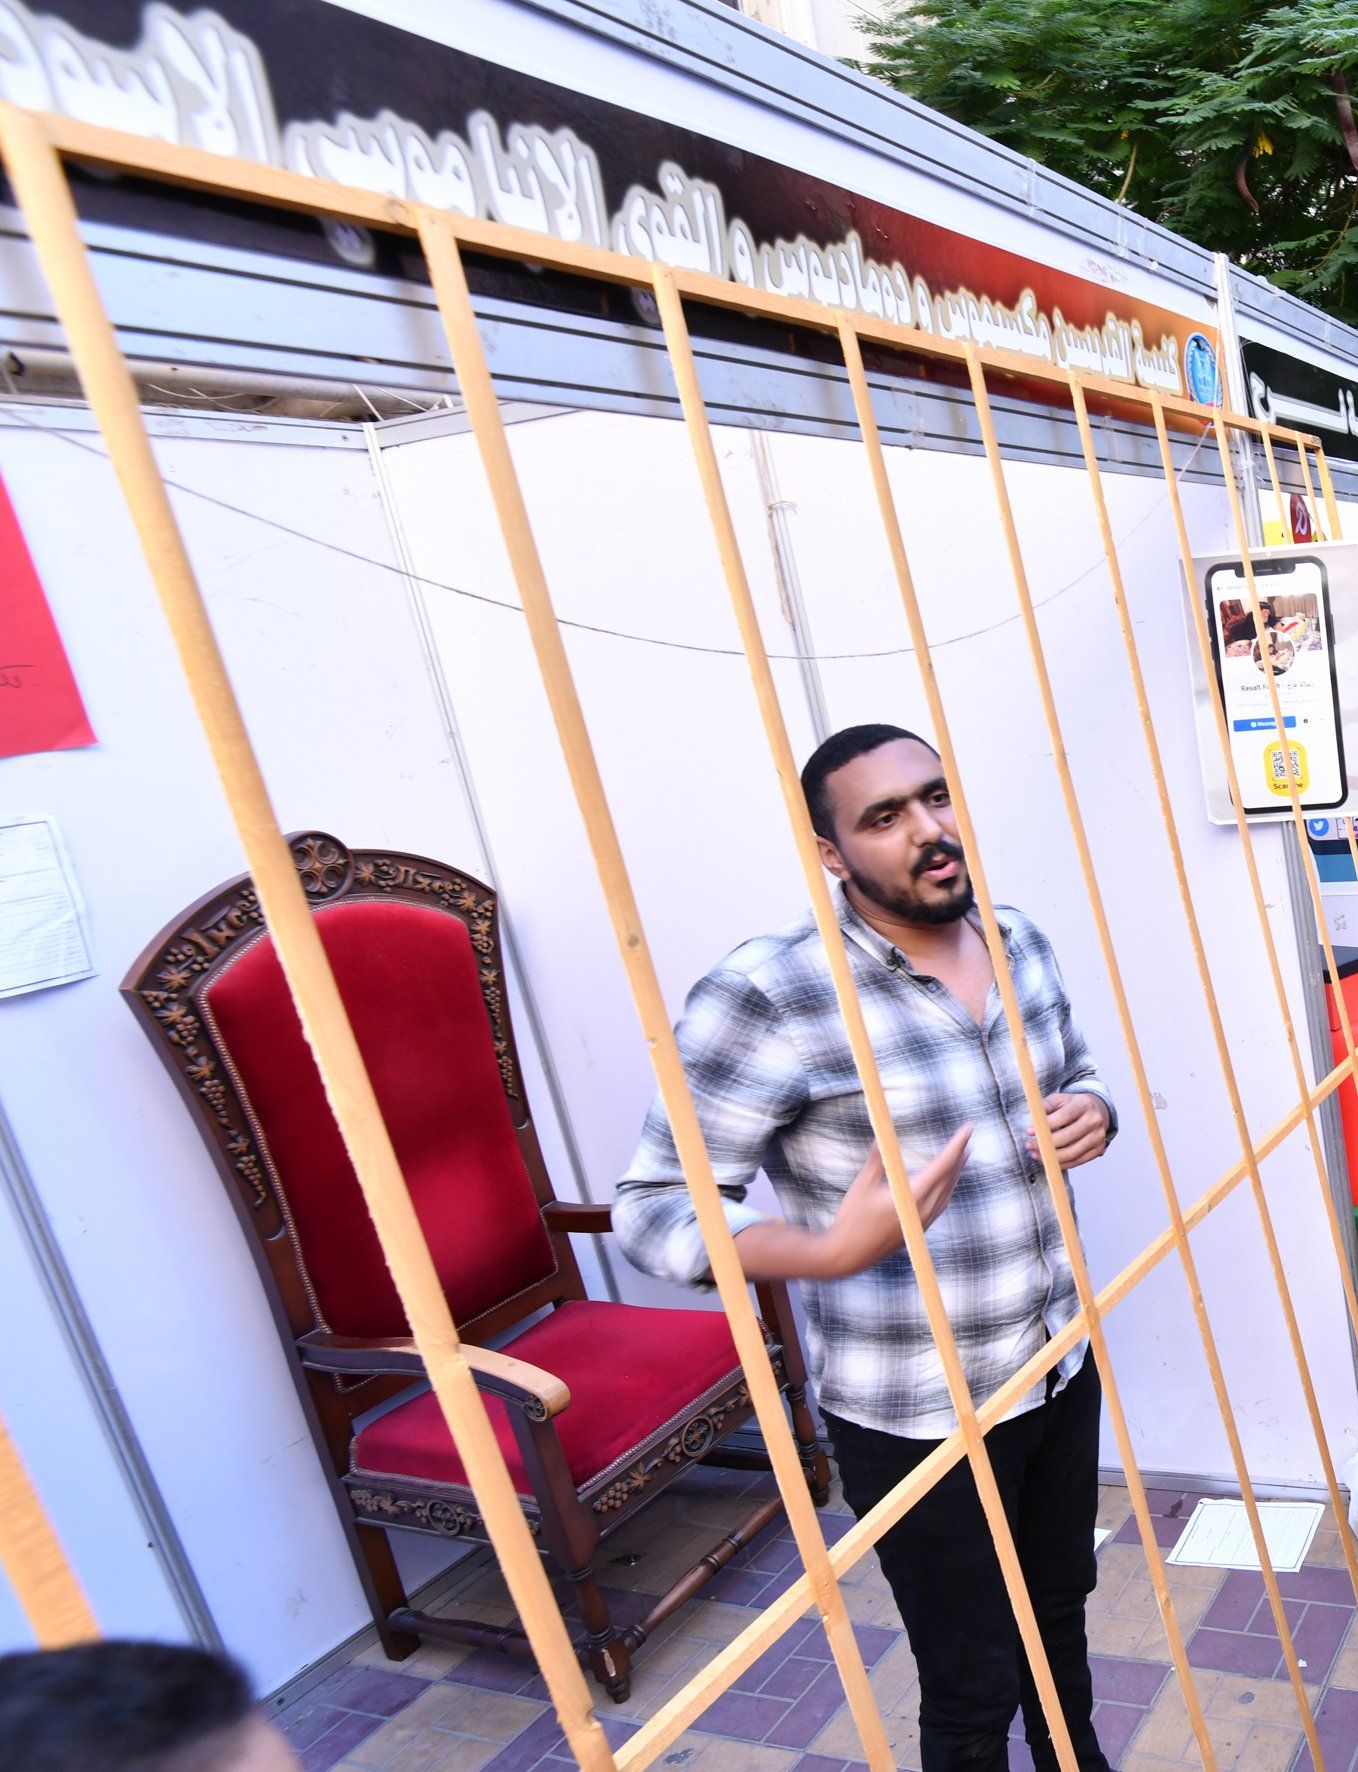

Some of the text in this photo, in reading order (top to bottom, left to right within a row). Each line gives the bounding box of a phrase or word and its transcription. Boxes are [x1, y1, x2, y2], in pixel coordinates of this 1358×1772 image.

[728, 219, 758, 288] و
[760, 230, 914, 328] دوماديوس
[913, 276, 934, 334] و
[935, 290, 1053, 364] مكسيموس
[1055, 308, 1134, 380] القديسين
[1132, 319, 1182, 395] كنيسة
